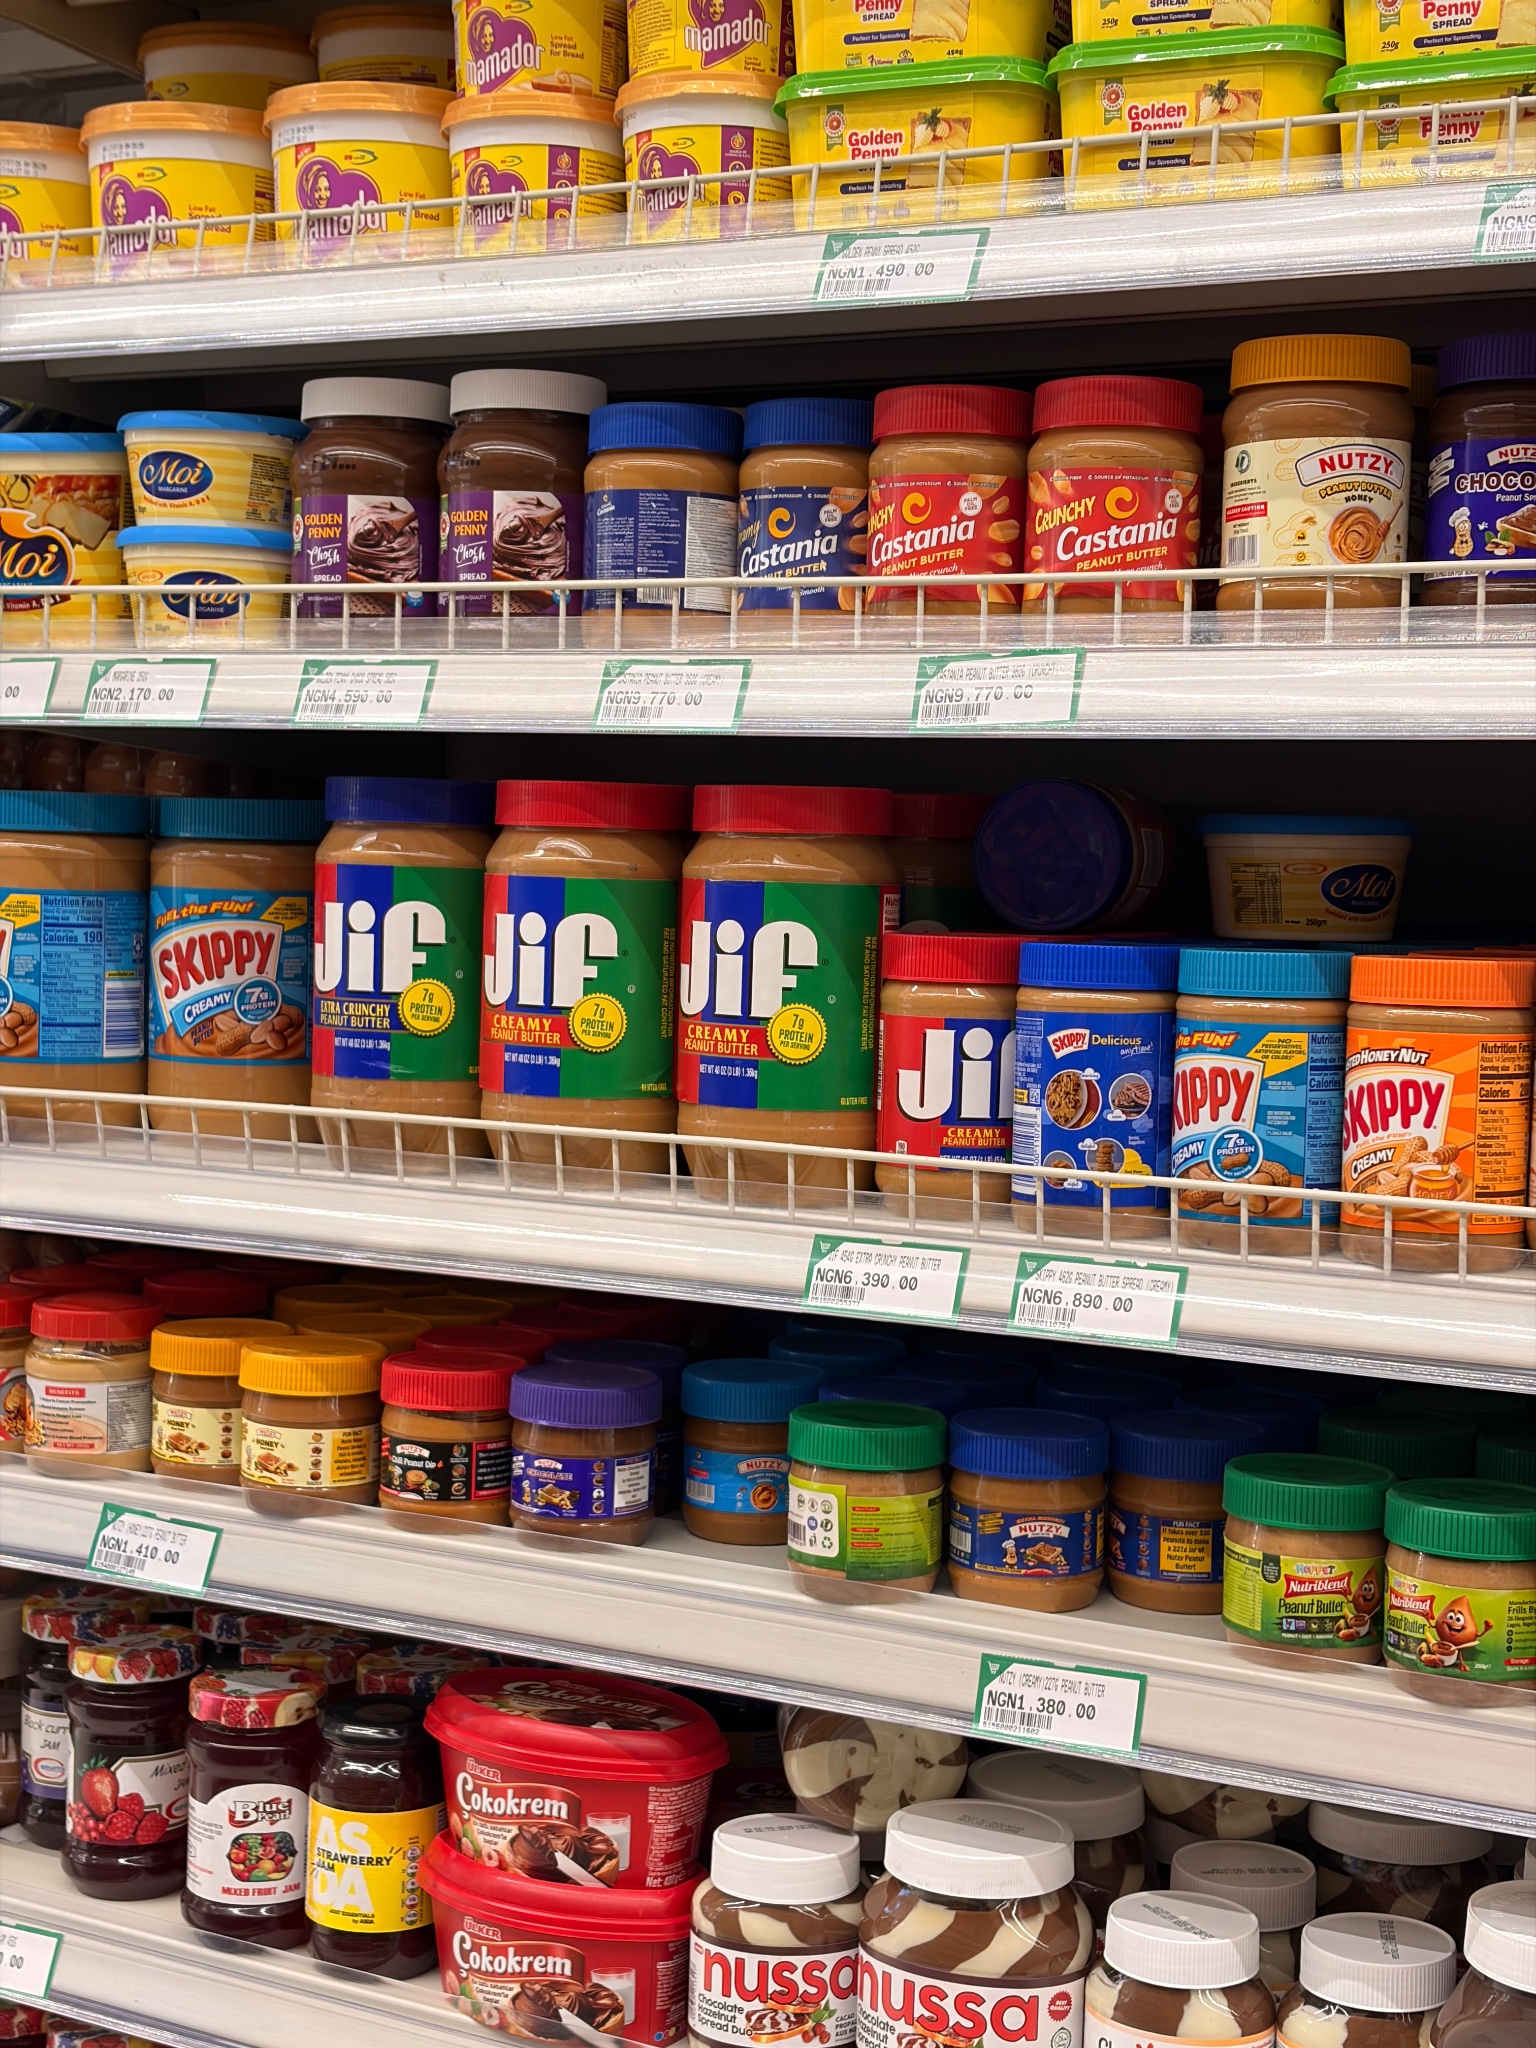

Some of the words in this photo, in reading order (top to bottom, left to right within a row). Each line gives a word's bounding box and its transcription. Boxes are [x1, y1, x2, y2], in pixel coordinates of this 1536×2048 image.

[862, 12, 896, 22] SPREAD
[1423, 1, 1482, 18] Penny
[684, 9, 772, 53] mamador
[1433, 18, 1473, 30] SPREAD
[550, 41, 577, 51] Spread
[1424, 36, 1444, 45] Perfect
[1453, 33, 1482, 43] Spreading
[465, 31, 545, 87] mamador
[550, 50, 561, 58] for
[562, 51, 585, 60] Bread
[1128, 103, 1187, 121] Golden
[848, 131, 903, 147] Golden
[1319, 452, 1393, 475] NUTZY
[143, 461, 205, 485] Moi
[158, 486, 188, 494] MARGARINE
[1319, 481, 1360, 499] PEANUT
[1361, 481, 1393, 500] BUTTER
[1344, 494, 1374, 504] HONEY
[305, 514, 343, 525] GOLDEN
[451, 510, 488, 523] GOLDEN
[1035, 495, 1096, 534] CRUNCHY
[308, 527, 342, 539] PENNY
[454, 524, 487, 536] PENNY
[1056, 512, 1178, 561] Castania
[872, 514, 976, 567] Castania
[741, 529, 838, 578] Castania
[881, 557, 918, 576] PEANUT
[920, 548, 964, 566] BUTTER
[1076, 554, 1123, 572] PEANUT
[1126, 546, 1168, 562] BUTTER
[459, 573, 488, 581] SPREAD
[785, 560, 828, 577] BUTTER
[313, 574, 342, 582] SPREAD
[1330, 872, 1394, 898] Moi
[43, 896, 80, 907] Nutrition
[82, 897, 103, 908] Facts
[155, 909, 180, 930] FUEL
[181, 903, 209, 917] the
[209, 900, 255, 915] FUN!
[43, 932, 78, 943] Calories
[84, 931, 103, 944] 190
[315, 900, 447, 993] Jif
[159, 930, 275, 999] SKIPPY
[484, 912, 619, 1007] Jif
[680, 920, 819, 1017] Jif
[245, 987, 269, 1002] 7g
[421, 988, 434, 1003] 7g
[184, 992, 232, 1023] CREAMY
[240, 1000, 277, 1011] PROTEIN
[320, 1000, 341, 1014] EXTRA
[343, 1002, 391, 1017] CRUNCHY
[409, 1002, 443, 1016] PROTEIN
[593, 1003, 605, 1019] 7g
[320, 1013, 348, 1026] PEANUT
[351, 1015, 391, 1029] BUTTER
[411, 1013, 420, 1021] PER
[493, 1014, 552, 1032] CREAMY
[580, 1017, 615, 1033] PROTEIN
[792, 1014, 804, 1030] 7g
[491, 1027, 518, 1042] PEANUT
[521, 1030, 561, 1044] BUTTER
[581, 1029, 591, 1037] PER
[591, 1030, 612, 1039] SERVING
[687, 1024, 750, 1042] CREAMY
[778, 1028, 814, 1044] PROTEIN
[1311, 1033, 1343, 1045] Nutrition
[684, 1038, 714, 1053] PEANUT
[718, 1041, 758, 1056] BUTTER
[780, 1041, 790, 1049] PER
[790, 1042, 811, 1051] SERVING
[1052, 1032, 1087, 1053] SKIPPY
[1092, 1035, 1142, 1046] Delicious
[1120, 1043, 1154, 1057] anytime!
[1481, 1043, 1517, 1054] Nutrition
[1361, 1049, 1398, 1064] HONEY
[1399, 1048, 1429, 1065] NUT
[1480, 1064, 1502, 1072] Serving
[1309, 1077, 1341, 1089] Calories
[1479, 1087, 1510, 1098] Calories
[1343, 1079, 1445, 1151] SKIPPY
[943, 1137, 976, 1146] PEANUT
[977, 1137, 1006, 1146] BUTTER
[948, 1128, 1001, 1138] CREAMY
[1223, 1133, 1245, 1148] 7g
[1217, 1146, 1255, 1156] PROTEIN
[1351, 1148, 1395, 1180] CREAMY
[855, 1252, 872, 1264] EXTRA
[874, 1254, 898, 1267] CRUNCHY
[899, 1256, 920, 1270] PEANUT
[921, 1258, 942, 1271] BUTTER
[815, 1267, 918, 1291] NGN6,390.00
[1075, 1272, 1096, 1286] PEANUT
[1098, 1274, 1120, 1288] BUTTER
[1122, 1276, 1144, 1290] SPREAD
[1145, 1279, 1174, 1294] (CREAMY)
[1022, 1287, 1133, 1312] NGN6,890.00
[166, 1419, 190, 1429] HONEY
[256, 1438, 280, 1448] HONEY
[400, 1445, 424, 1455] NUTZY
[746, 1459, 783, 1471] NUTZY
[526, 1469, 574, 1481] CHOCOLATE
[1018, 1524, 1062, 1534] NUTZY
[1287, 1576, 1348, 1594] Nutriblend
[1278, 1598, 1316, 1615] Peanut
[1316, 1600, 1345, 1615] Butter
[1390, 1593, 1431, 1611] Nutriblend
[1060, 1679, 1082, 1694] PEANUT
[1083, 1681, 1106, 1698] BUTTER
[986, 1689, 1097, 1720] NGN1,380.00
[40, 1740, 61, 1751] JAM
[466, 1757, 501, 1782] ÜLKER
[456, 1772, 569, 1820] Çokokrem
[233, 1800, 290, 1822] Blue
[257, 1811, 290, 1823] Pearl
[316, 1846, 393, 1867] STRAWBERRY
[316, 1860, 336, 1873] JAM
[221, 1886, 250, 1897] MIXED
[252, 1886, 277, 1897] FRUIT
[282, 1882, 301, 1894] JAM
[464, 1916, 502, 1941] ÜLKER
[453, 1930, 572, 1978] Çokokrem
[704, 1948, 859, 2004] nussa
[698, 1993, 745, 2015] Chocolate
[858, 1954, 1040, 2043] nussa
[698, 2005, 737, 2024] Hazelnut
[835, 2012, 855, 2022] CACAO
[697, 2014, 729, 2033] Spread
[731, 2025, 753, 2037] Duo
